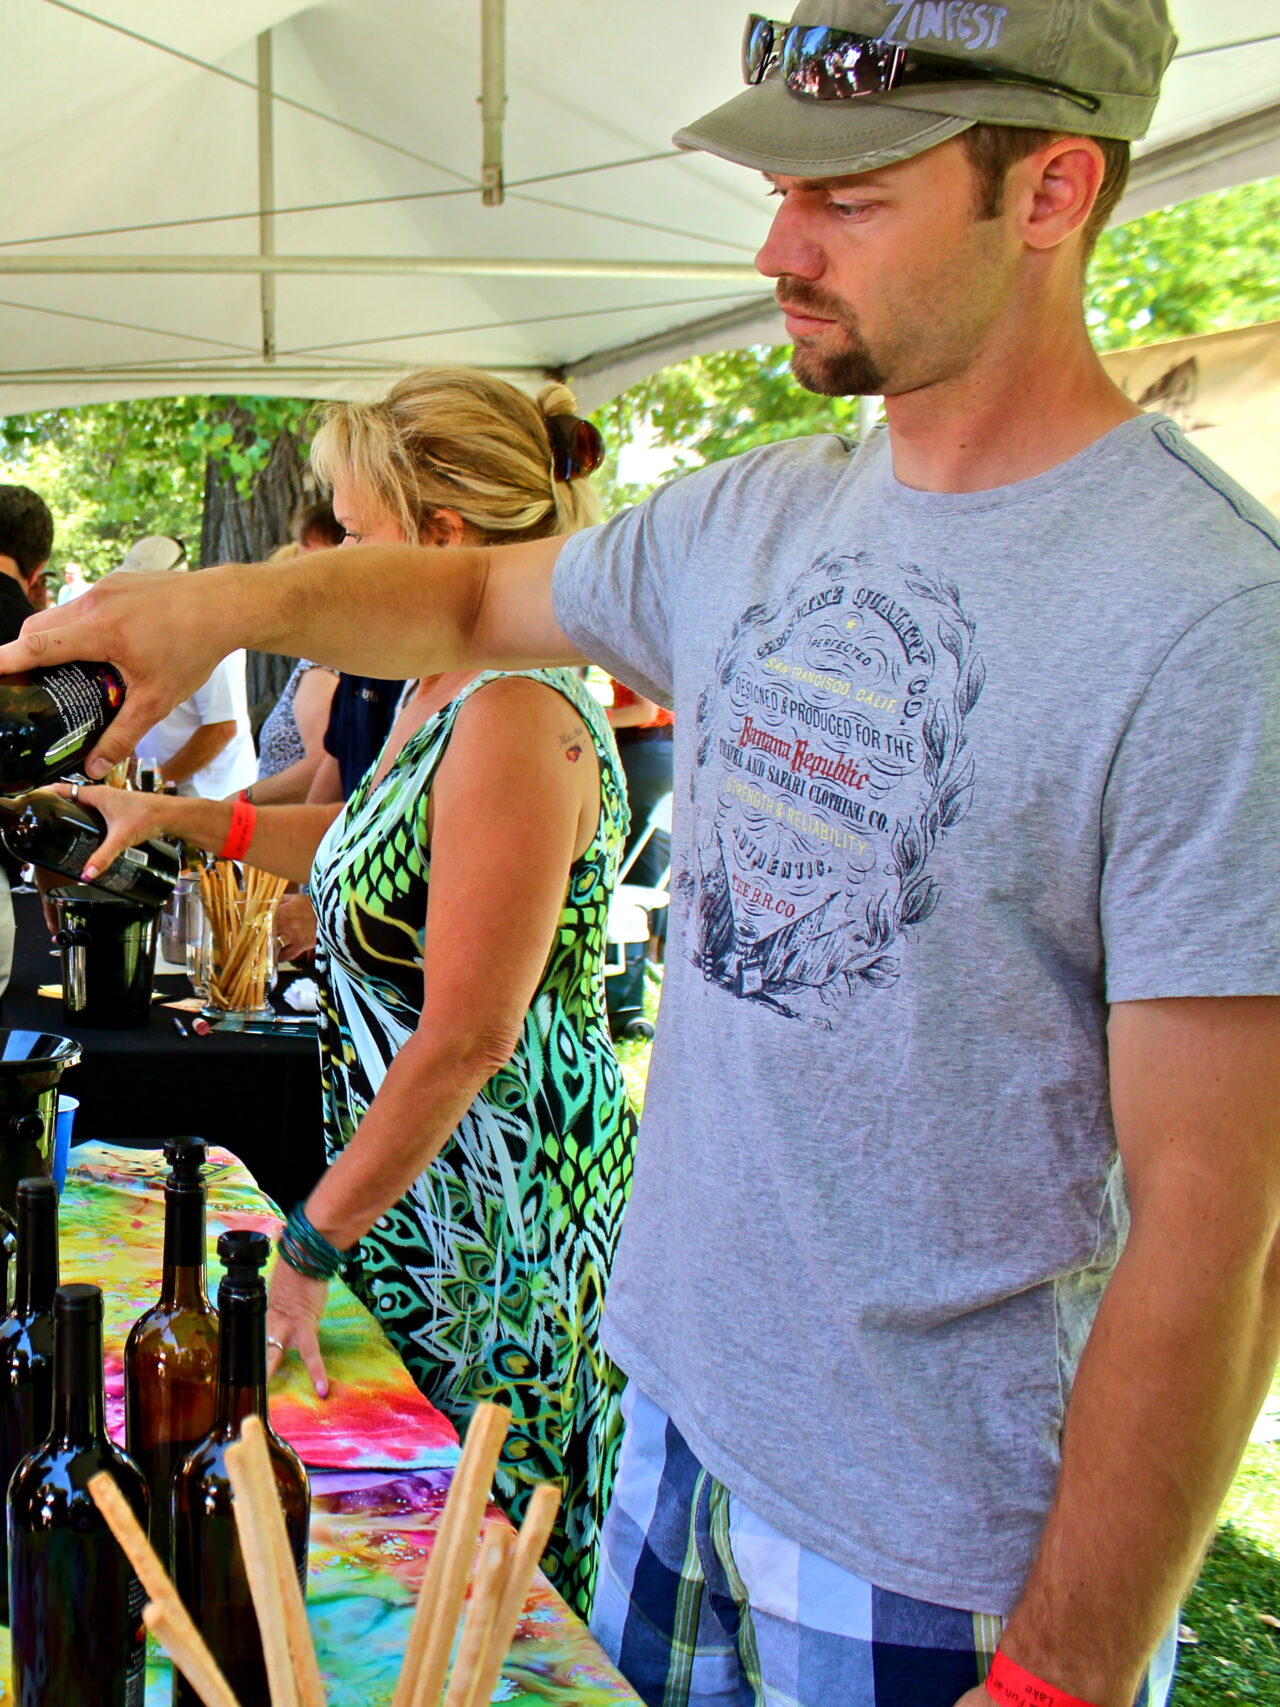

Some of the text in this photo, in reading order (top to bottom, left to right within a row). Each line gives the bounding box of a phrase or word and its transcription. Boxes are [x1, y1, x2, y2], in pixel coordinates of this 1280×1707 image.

[879, 0, 1008, 49] ZINFEST
[809, 637, 872, 666] PERFECTED
[852, 586, 931, 665] QUALITY
[735, 676, 917, 763] DESIGNED & PRODUCED FOR THE
[765, 657, 789, 675] SAN
[856, 689, 898, 714] CALIF.
[738, 715, 870, 790] Banana Republic
[725, 776, 868, 856] STRENGTH & RELIABILITY
[745, 755, 765, 777] AND
[767, 764, 807, 798] SAFARI
[808, 784, 866, 823] CLOTHING
[869, 810, 889, 834] CO.
[1024, 1684, 1054, 1707] Lake
